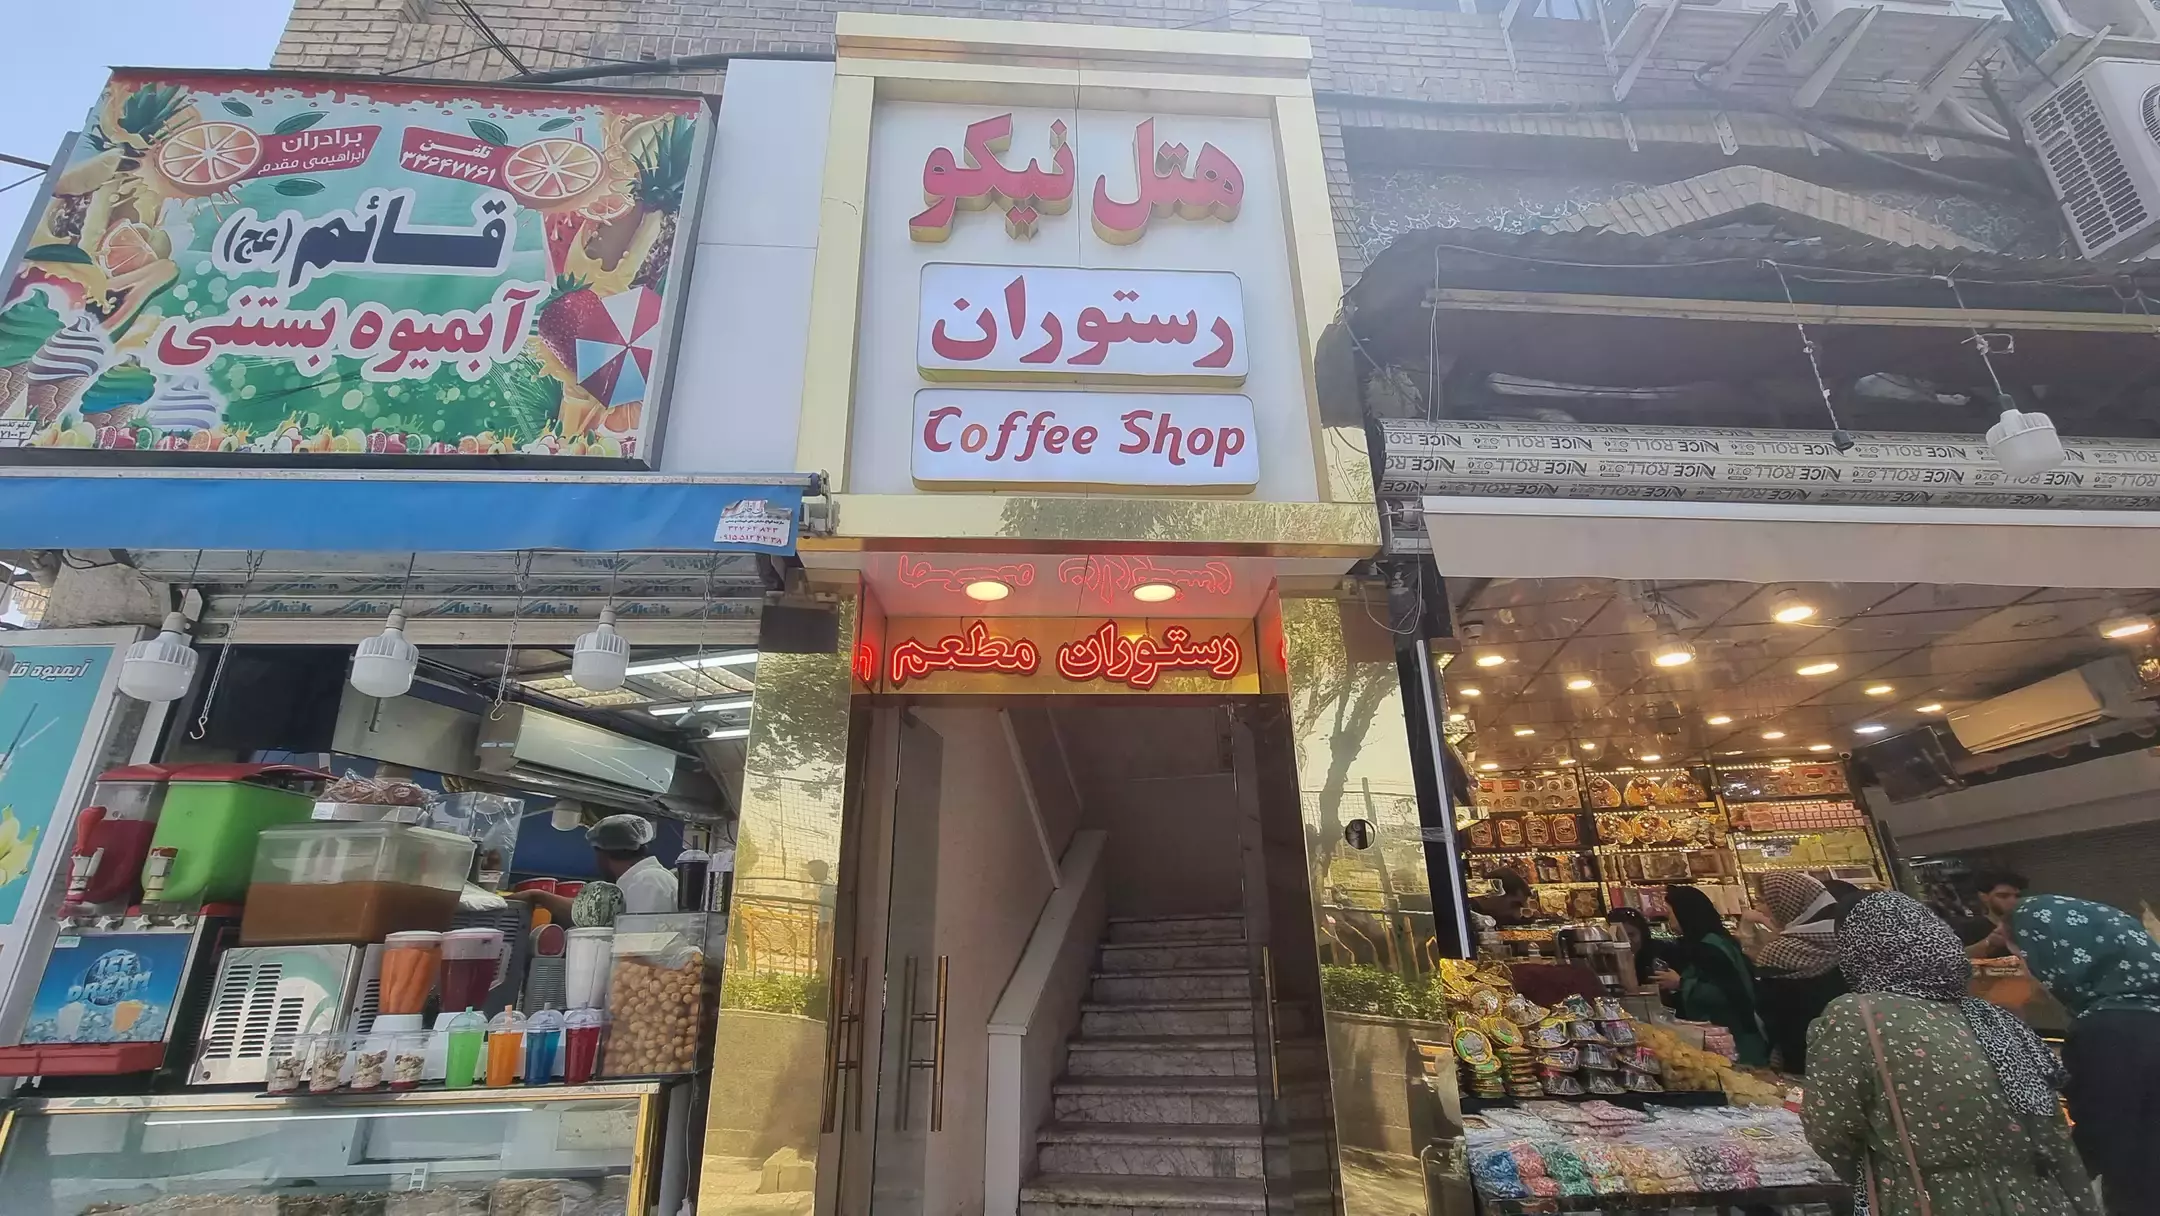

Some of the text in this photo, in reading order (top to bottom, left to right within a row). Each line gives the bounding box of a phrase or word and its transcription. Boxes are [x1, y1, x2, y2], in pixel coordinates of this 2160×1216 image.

[281, 129, 363, 152] برادران
[419, 139, 494, 159] تلفن
[257, 148, 365, 176] ابراهیمی مقدم
[400, 151, 496, 182] ۳۳۶۴۷۷۶۱
[908, 113, 1245, 236] هتل نیکو
[223, 195, 507, 288] قائم (عج)
[157, 287, 541, 373] آبمیوه بستنی
[931, 274, 1235, 369] رستوران
[923, 406, 1246, 468] Coffee Shop
[1419, 434, 1464, 448] NICE
[1506, 435, 1595, 451] NICE ROLL
[1634, 438, 1723, 454] NICE ROLL
[1756, 441, 1799, 454] ROLL
[1881, 445, 1969, 460] NICE ROLL
[1411, 456, 1459, 474] NICE
[1500, 459, 1589, 477] NICE ROLL
[1631, 462, 1717, 480] NICE ROLL
[1756, 465, 1842, 482] NICE ROLL
[1881, 467, 1966, 485] NICE ROLL
[2044, 471, 2085, 488] NICE
[1515, 482, 1560, 496] NICE
[1643, 485, 1687, 499] NICE
[1768, 488, 1812, 501] NICE
[892, 624, 1039, 682] مطعم
[1058, 624, 1240, 686] رستوران
[31, 659, 93, 681] آبمیوه
[97, 952, 137, 976] ICE
[67, 971, 152, 1002] DREAM
